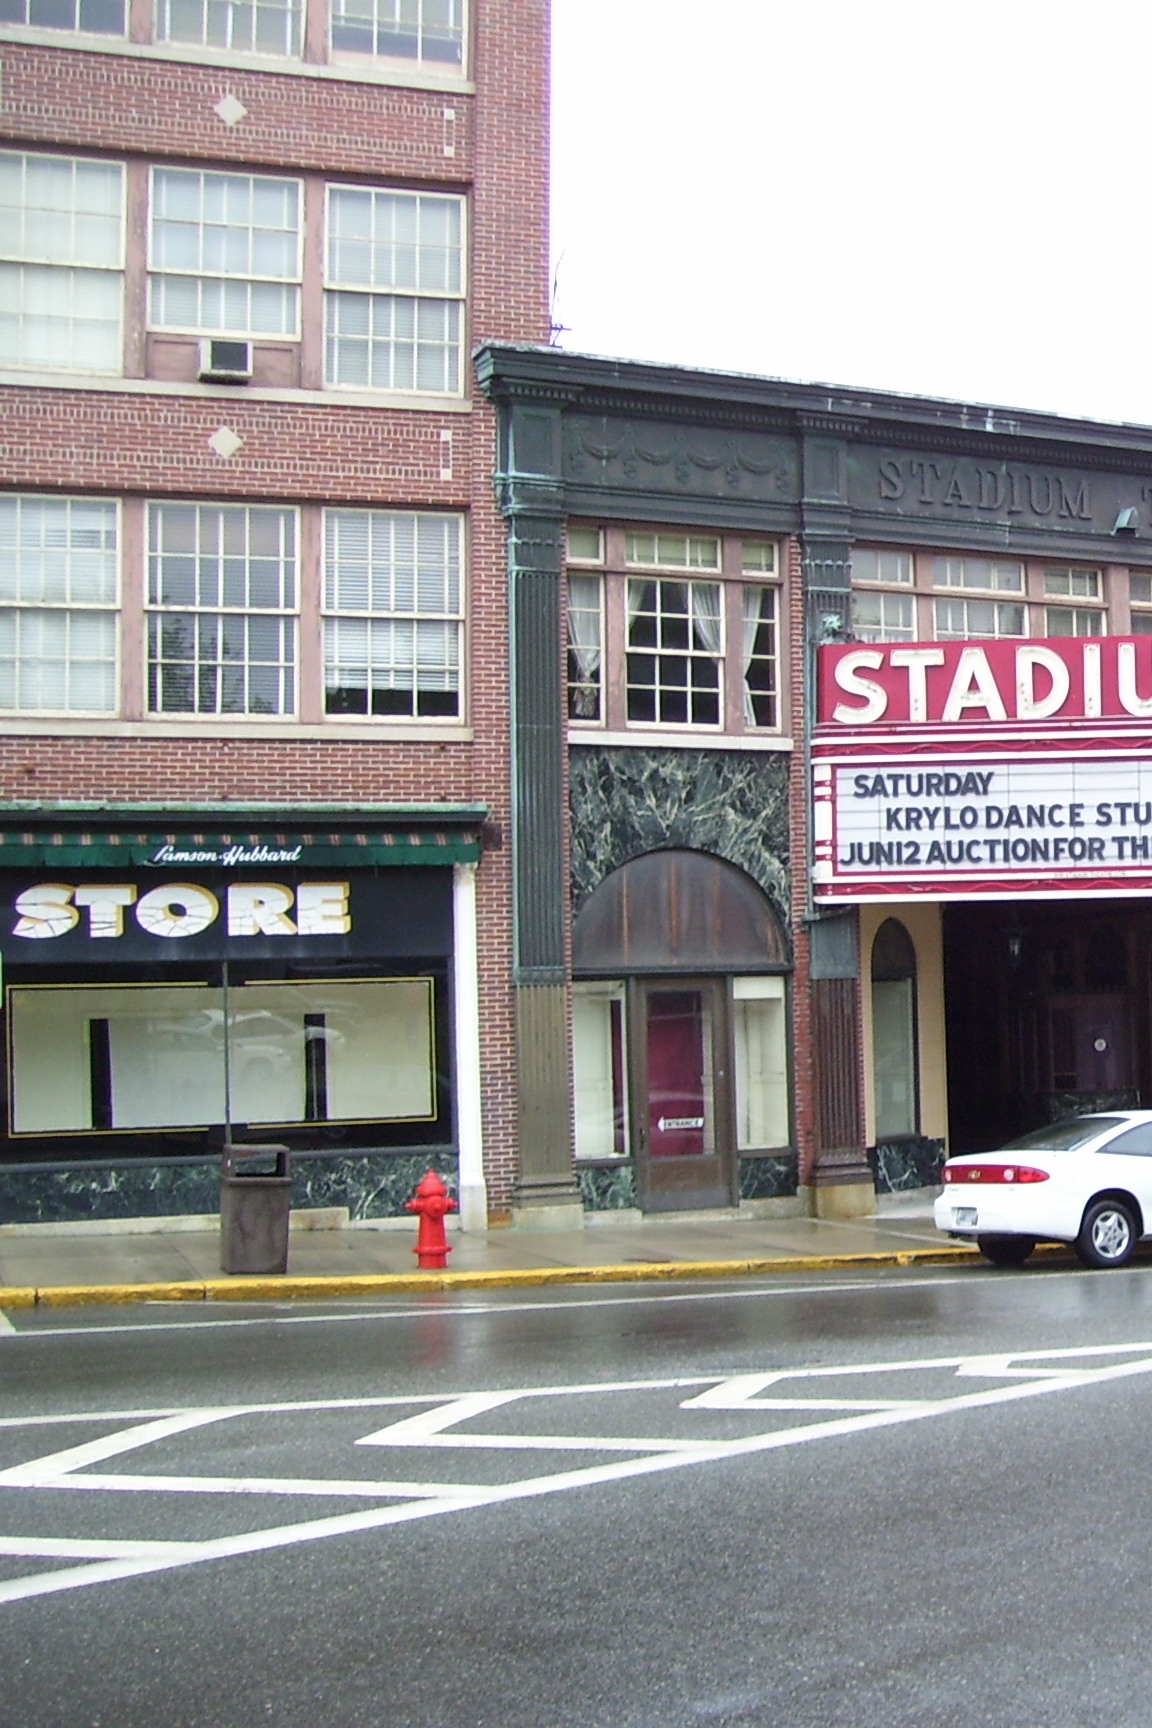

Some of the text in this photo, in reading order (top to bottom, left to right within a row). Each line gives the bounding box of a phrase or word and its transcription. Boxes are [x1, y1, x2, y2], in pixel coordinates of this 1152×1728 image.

[879, 460, 1093, 522] STADIUM
[853, 771, 995, 798] SATURDAY
[886, 806, 978, 831] KRYLO
[985, 802, 1085, 830] DANCE
[11, 881, 351, 939] STORE
